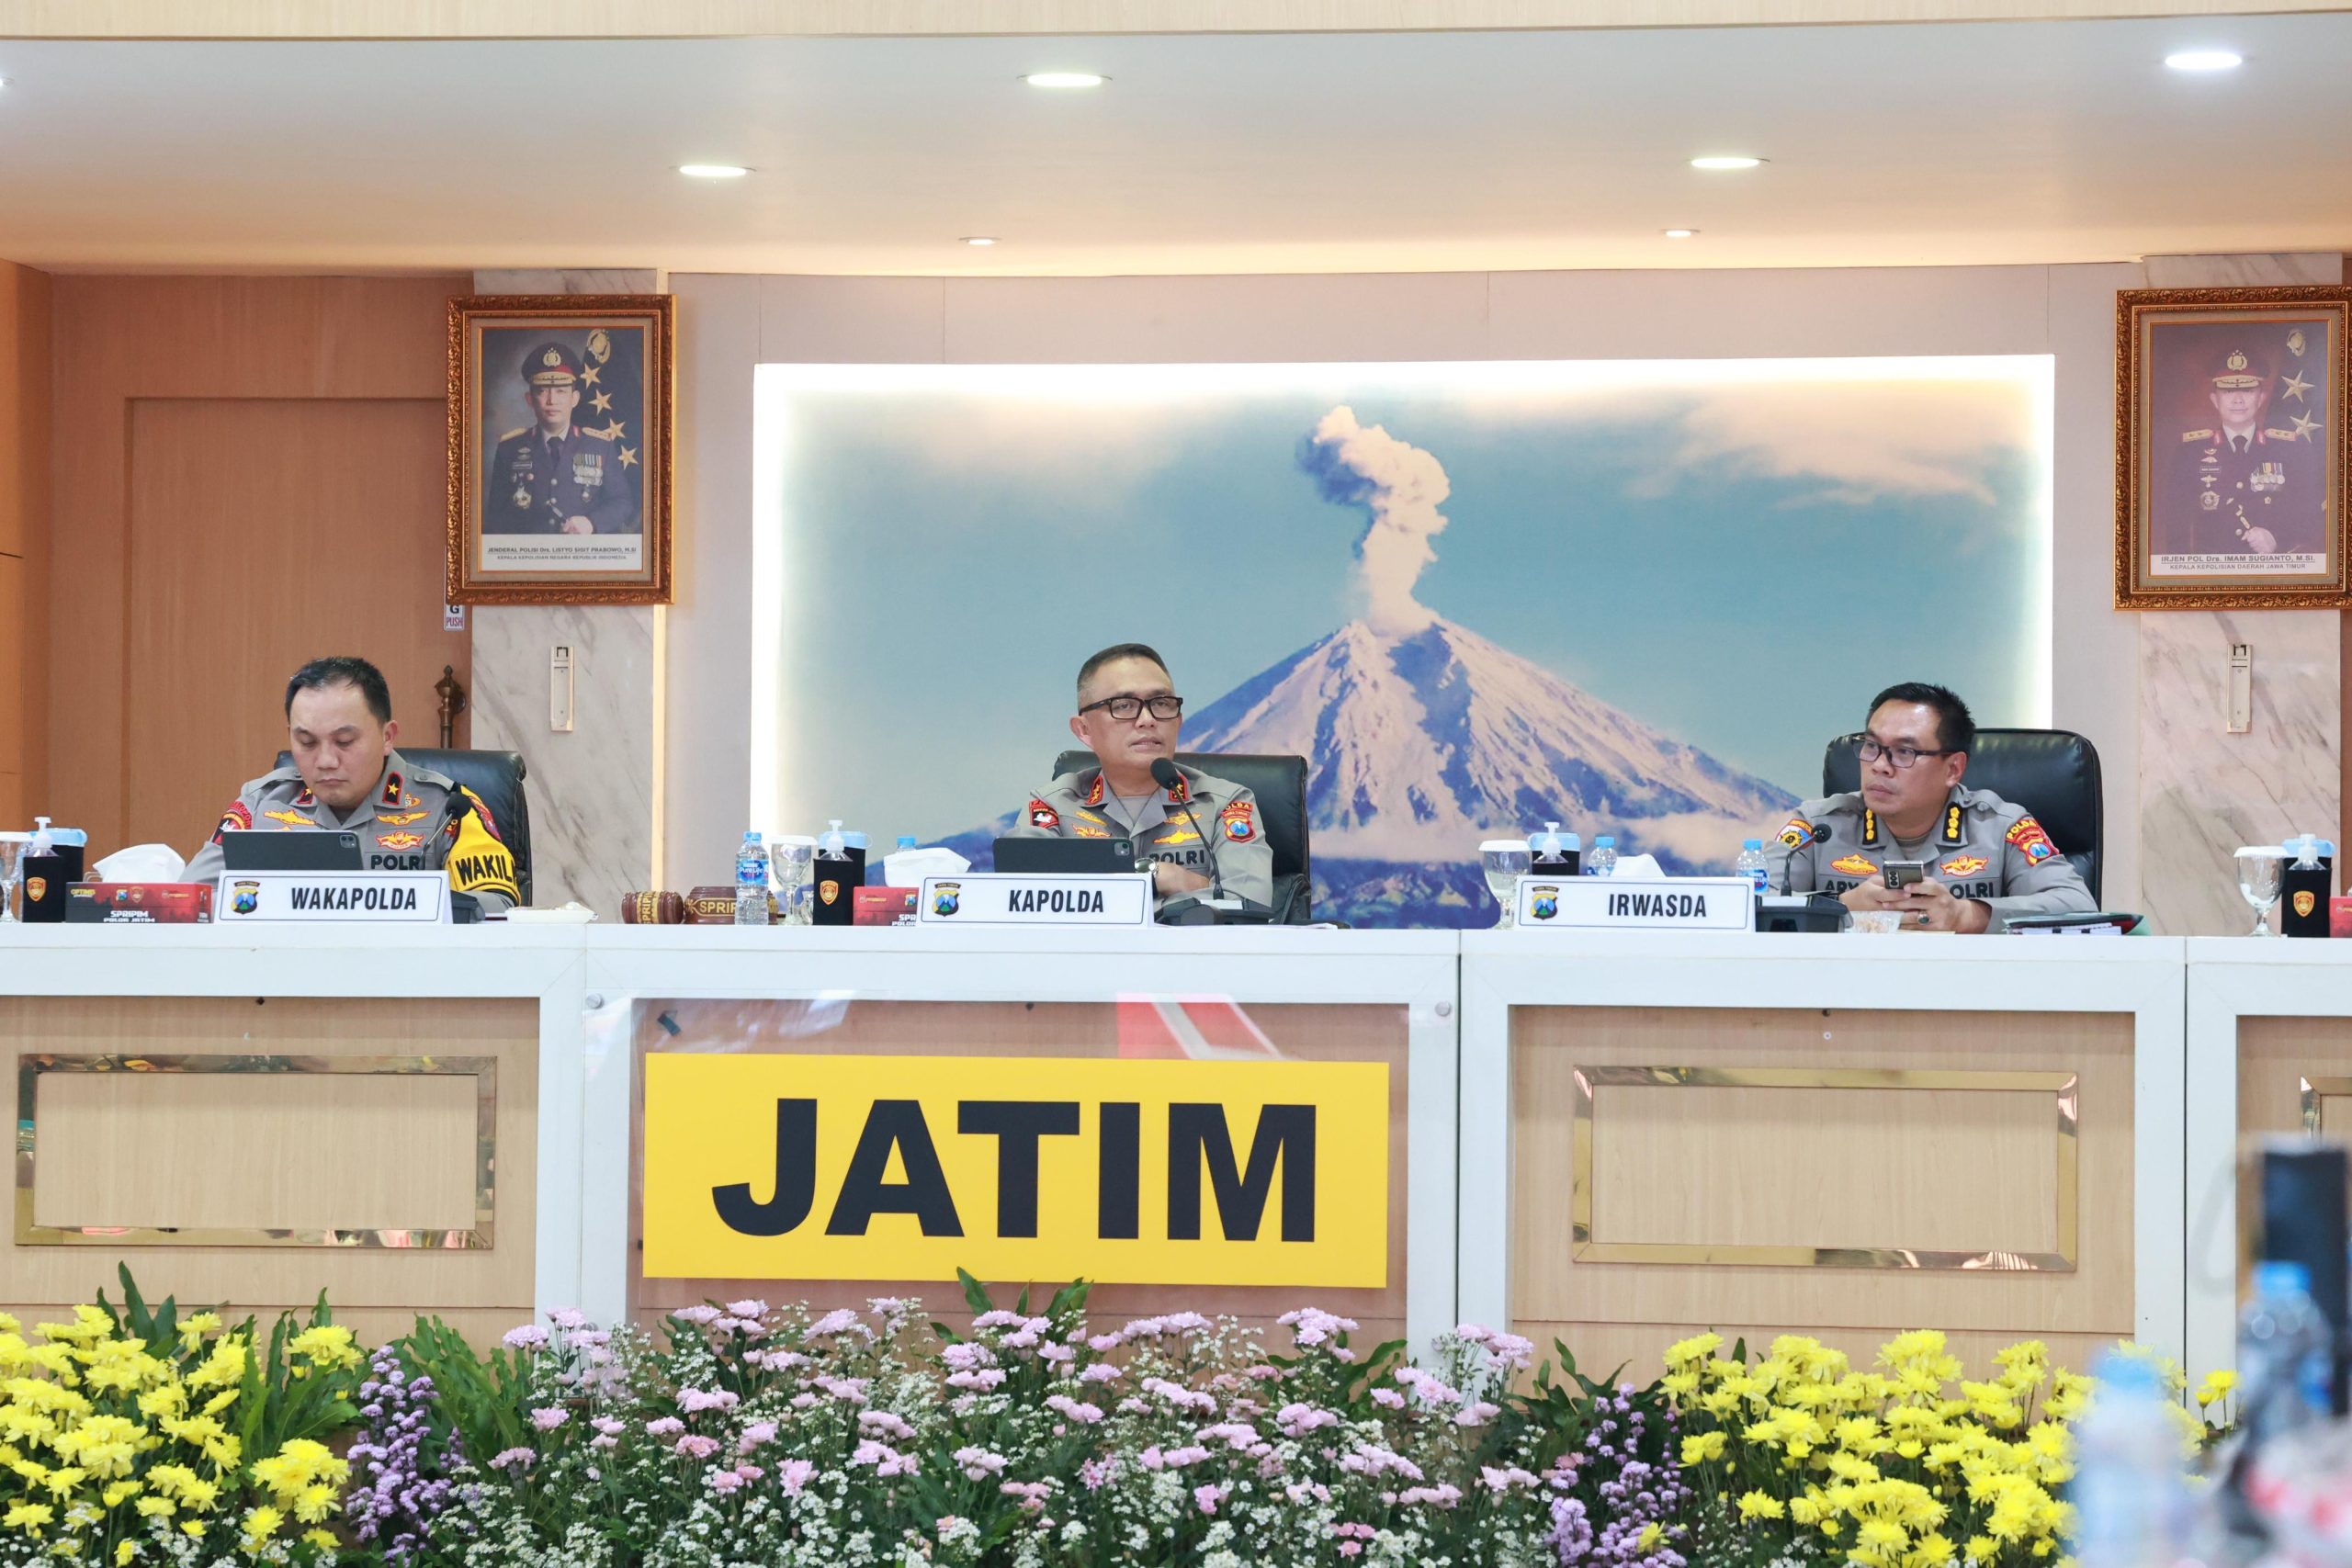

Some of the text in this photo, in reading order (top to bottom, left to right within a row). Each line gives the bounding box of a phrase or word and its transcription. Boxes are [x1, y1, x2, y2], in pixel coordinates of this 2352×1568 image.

[446, 616, 463, 626] PUSH
[1225, 802, 1250, 810] OLDA
[2007, 818, 2037, 840] POLDA
[456, 854, 513, 886] WAKIL
[291, 887, 416, 910] WAKAPOLDA
[1009, 889, 1103, 913] KAPOLDA
[1949, 881, 1995, 899] OLRI
[699, 900, 736, 913] SPRIP
[1609, 894, 1707, 918] IRWASDA
[712, 1098, 1317, 1243] JATIM
